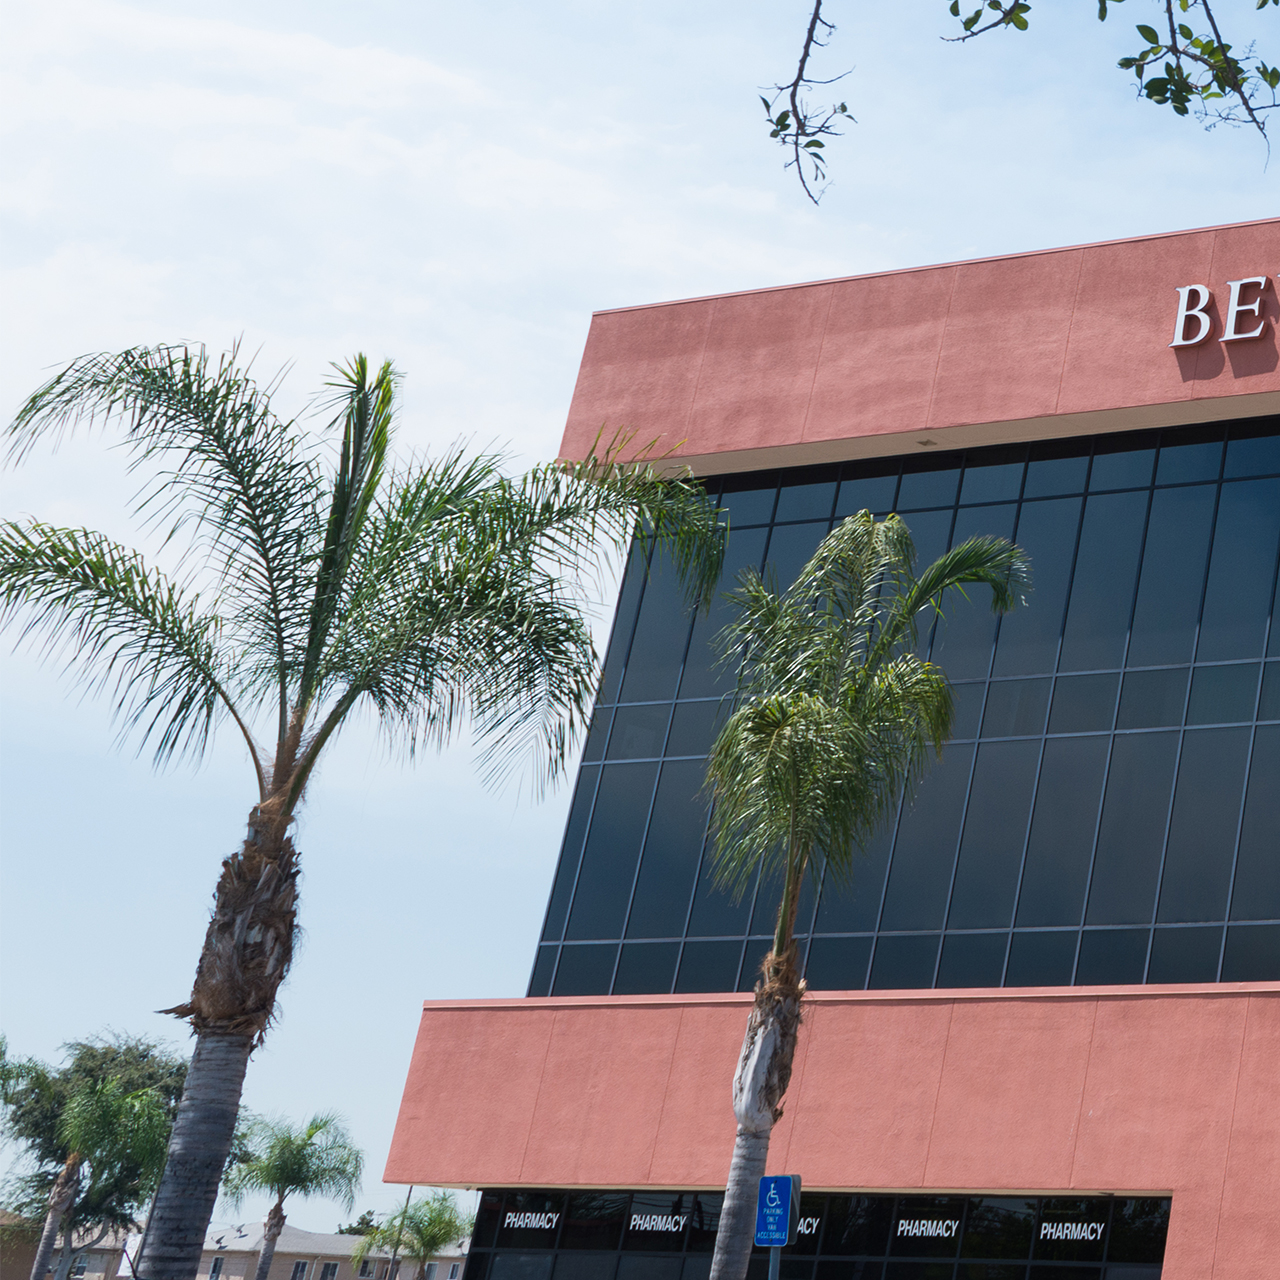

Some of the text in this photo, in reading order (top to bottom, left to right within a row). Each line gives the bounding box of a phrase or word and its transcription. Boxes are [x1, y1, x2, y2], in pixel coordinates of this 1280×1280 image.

[503, 1212, 560, 1229] PHARMACY
[629, 1214, 686, 1232] PHARMACY
[897, 1220, 959, 1238] PHARMACY
[757, 1231, 786, 1239] ACCESSIBLE
[1039, 1222, 1105, 1240] PHARMACY
